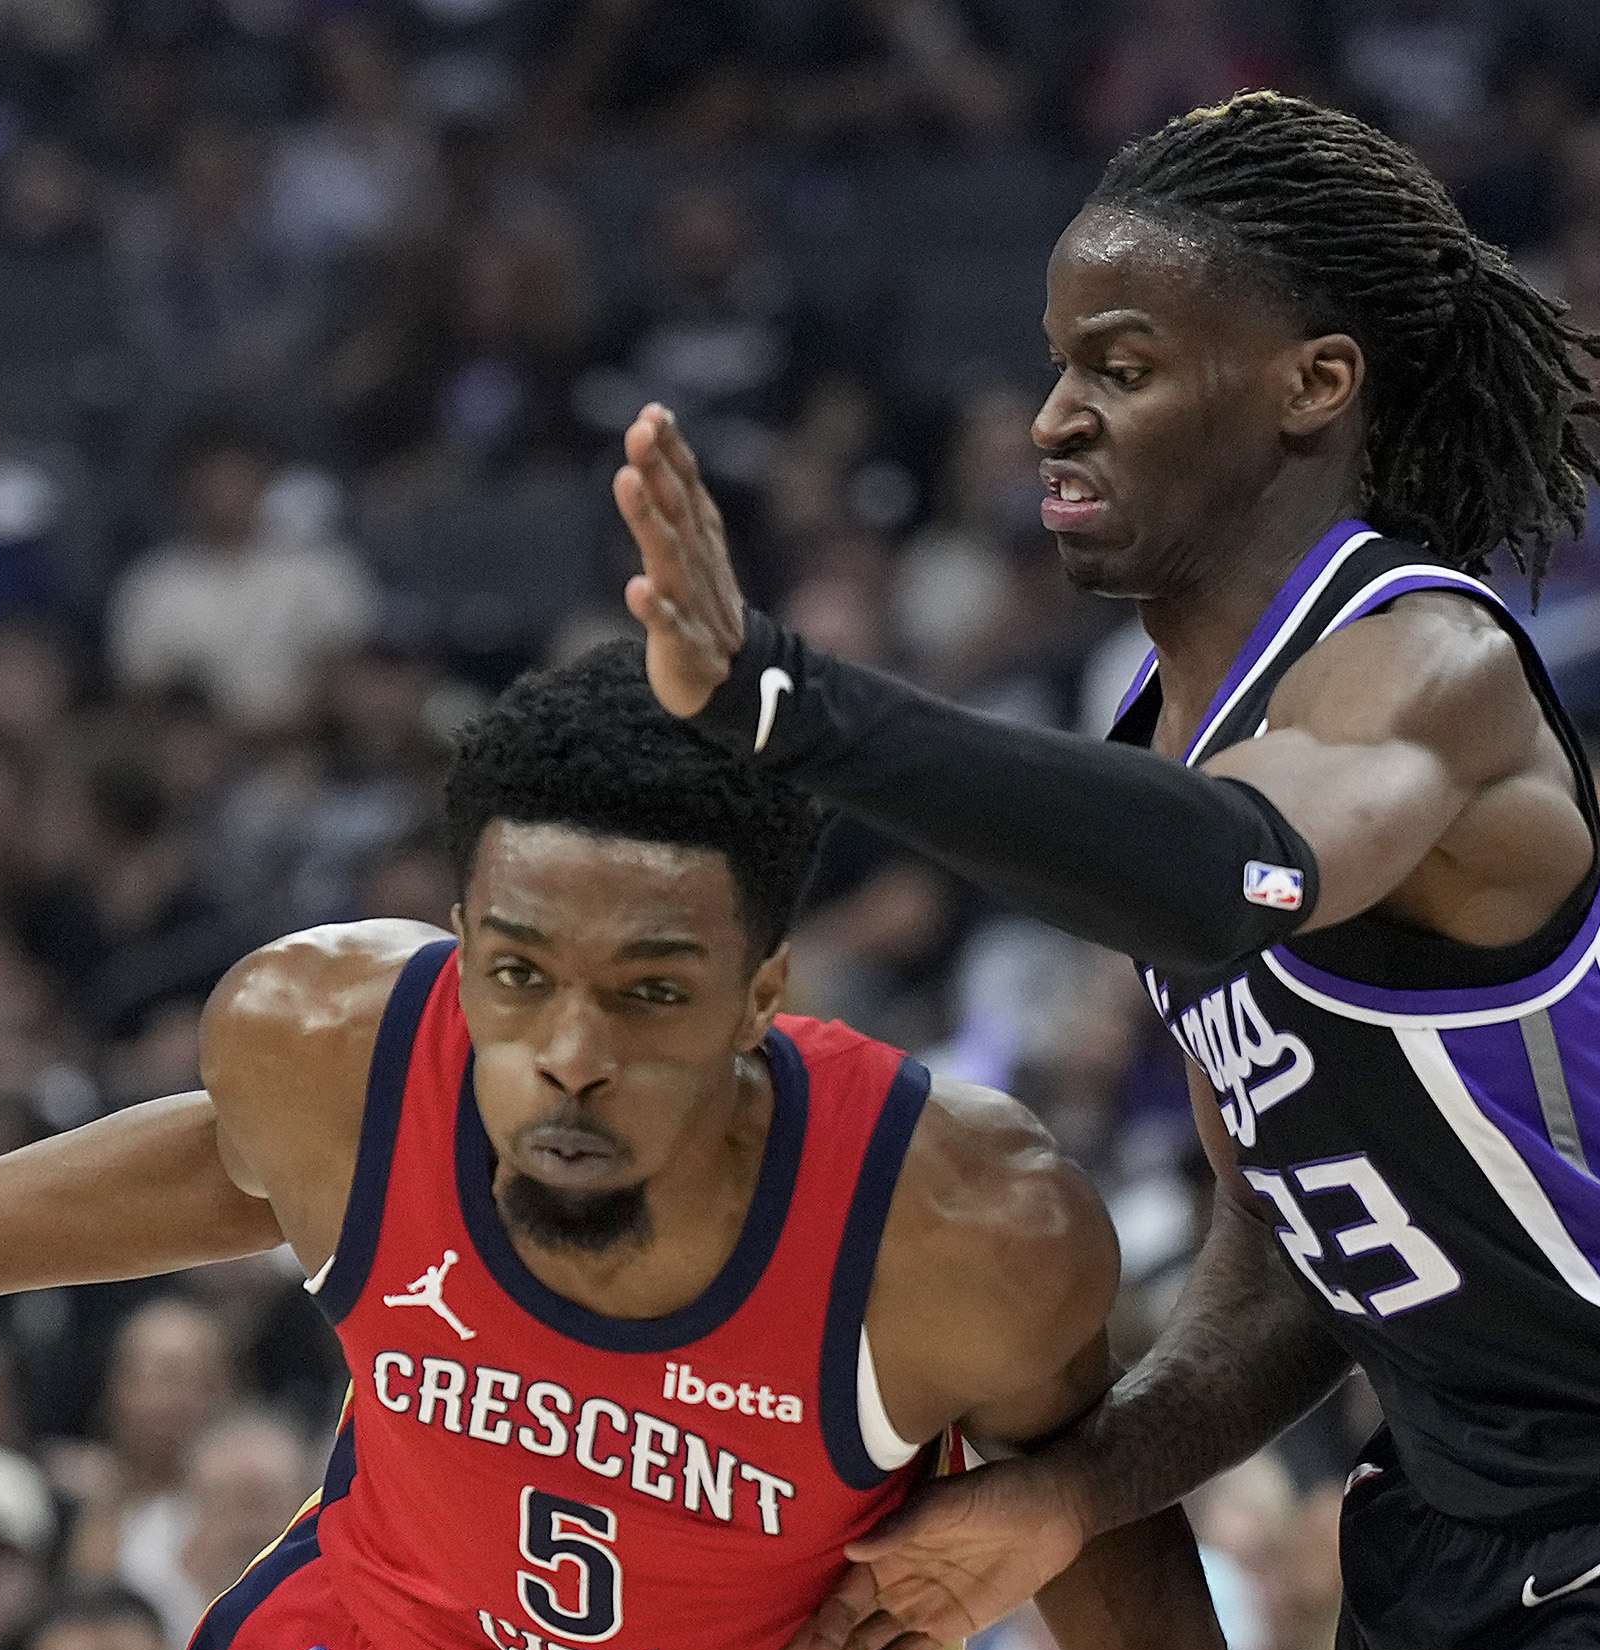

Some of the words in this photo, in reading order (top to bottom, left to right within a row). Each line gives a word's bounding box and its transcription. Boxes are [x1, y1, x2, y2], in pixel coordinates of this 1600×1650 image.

[372, 1350, 797, 1536] CRESCENT
[662, 1362, 804, 1424] ibotta
[516, 1485, 624, 1645] 5
